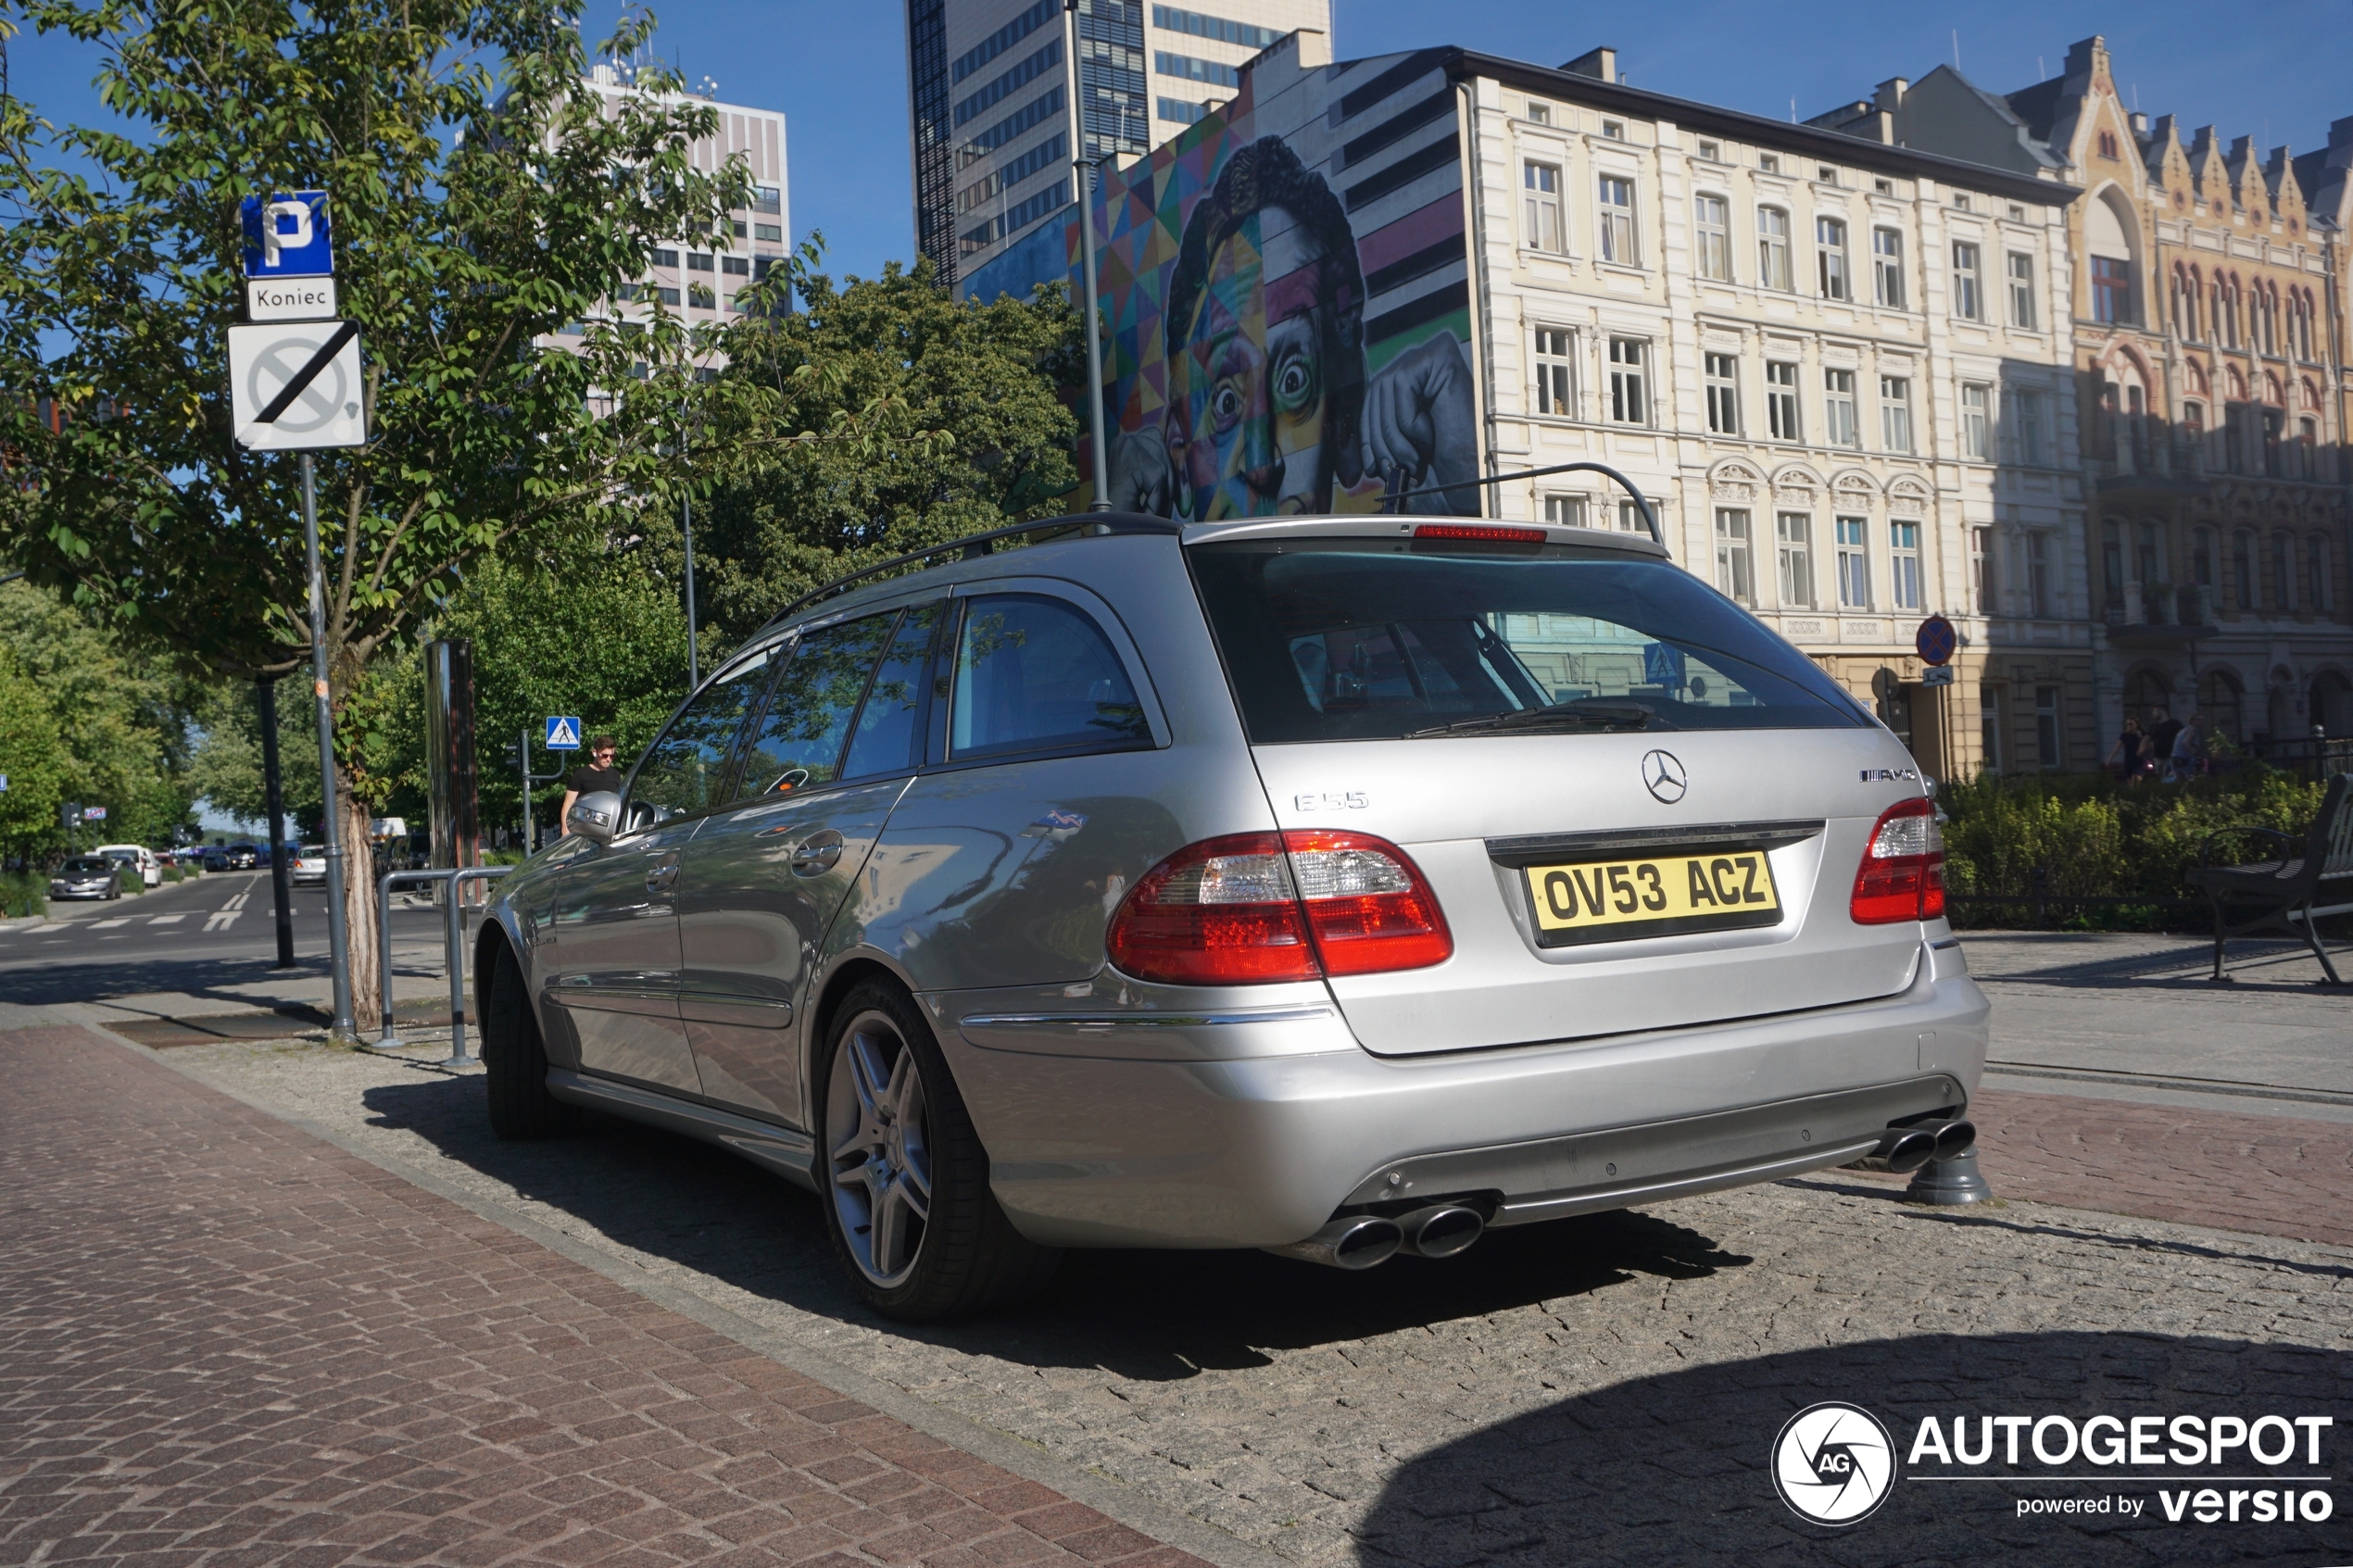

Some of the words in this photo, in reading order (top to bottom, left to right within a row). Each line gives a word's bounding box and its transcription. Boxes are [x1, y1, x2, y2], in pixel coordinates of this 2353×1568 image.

[262, 200, 313, 268] P
[257, 288, 326, 307] Koniec
[1543, 863, 1667, 920] OV53
[1687, 857, 1767, 909] ACZ
